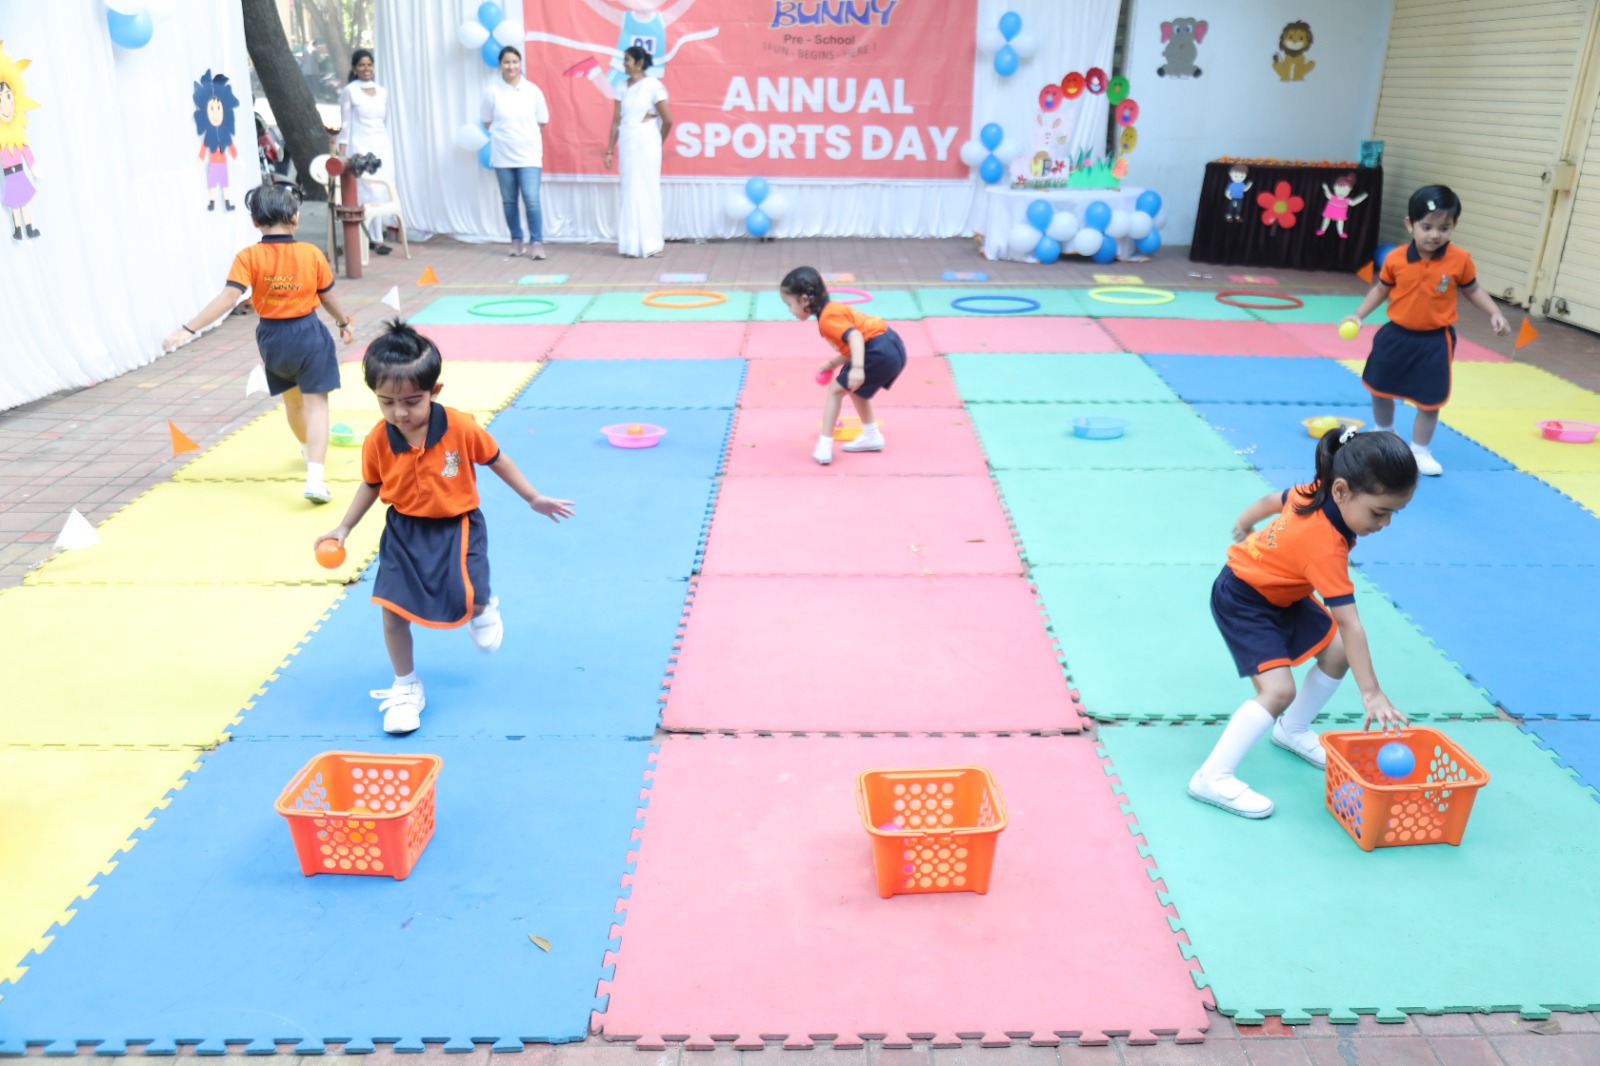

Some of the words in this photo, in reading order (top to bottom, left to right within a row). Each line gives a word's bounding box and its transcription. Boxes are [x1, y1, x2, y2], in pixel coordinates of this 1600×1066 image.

[769, 0, 898, 28] BUNNY
[784, 34, 804, 45] Pre
[815, 34, 856, 46] School
[798, 49, 835, 60] BEGINS
[721, 76, 914, 114] ANNUAL
[675, 121, 852, 160] SPORTS
[861, 125, 960, 161] DAY
